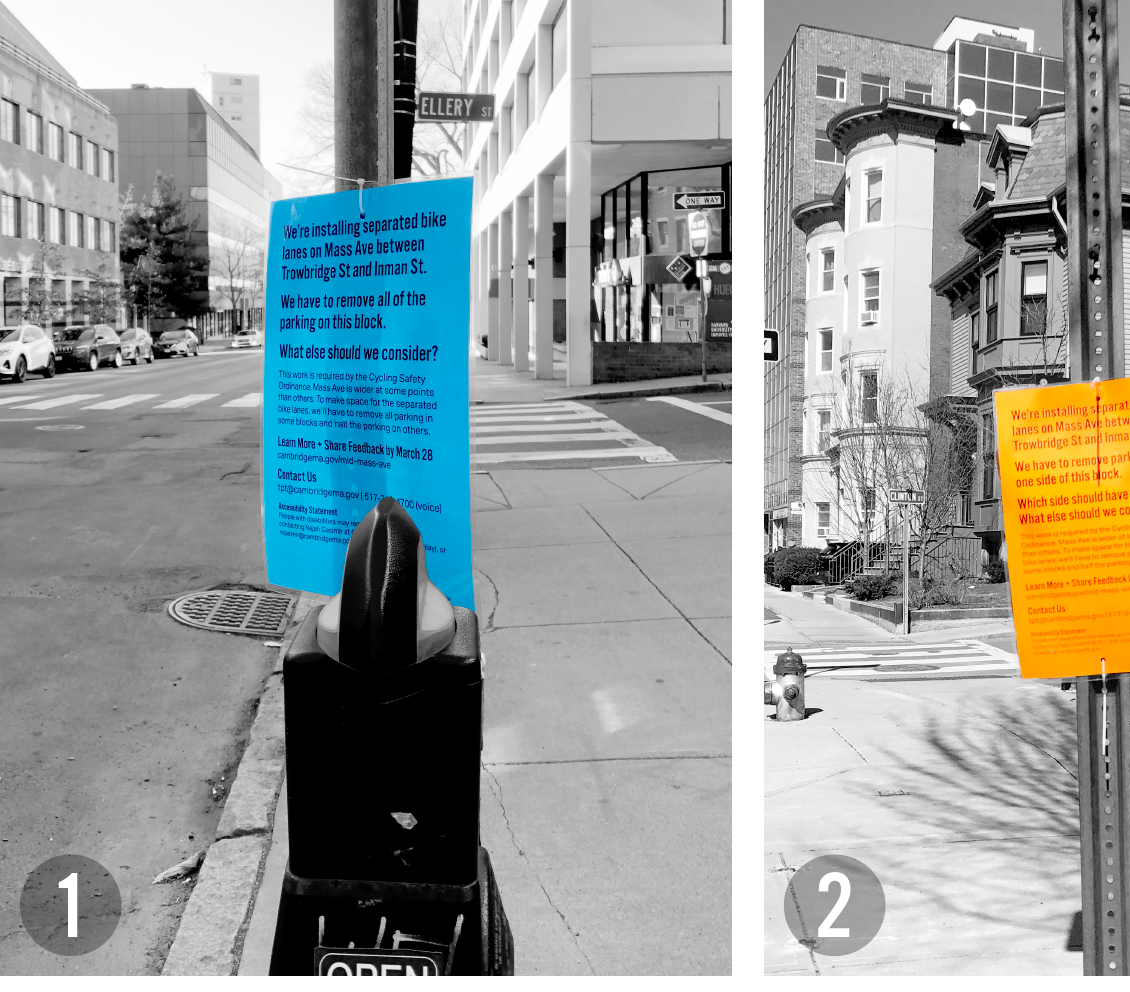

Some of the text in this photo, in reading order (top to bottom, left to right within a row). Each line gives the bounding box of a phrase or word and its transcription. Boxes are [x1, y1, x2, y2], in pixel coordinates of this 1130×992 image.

[421, 97, 492, 117] ELLERY ST
[284, 211, 446, 239] We're installing separated bike
[282, 238, 424, 259] lanes on Mass Ave between
[282, 259, 427, 281] Trowbridge St and Inman St.
[1011, 409, 1040, 421] We're
[1042, 405, 1088, 418] installing
[1012, 423, 1039, 436] lanes
[1042, 422, 1053, 433] on
[1056, 421, 1082, 432] Mass
[1085, 418, 1102, 429] Ave
[1013, 437, 1068, 451] Trowbridge
[1071, 436, 1082, 446] St
[1085, 434, 1103, 445] and
[278, 469, 317, 482] Contact Us
[891, 493, 916, 501] CLINTON
[327, 962, 428, 976] OPEN
